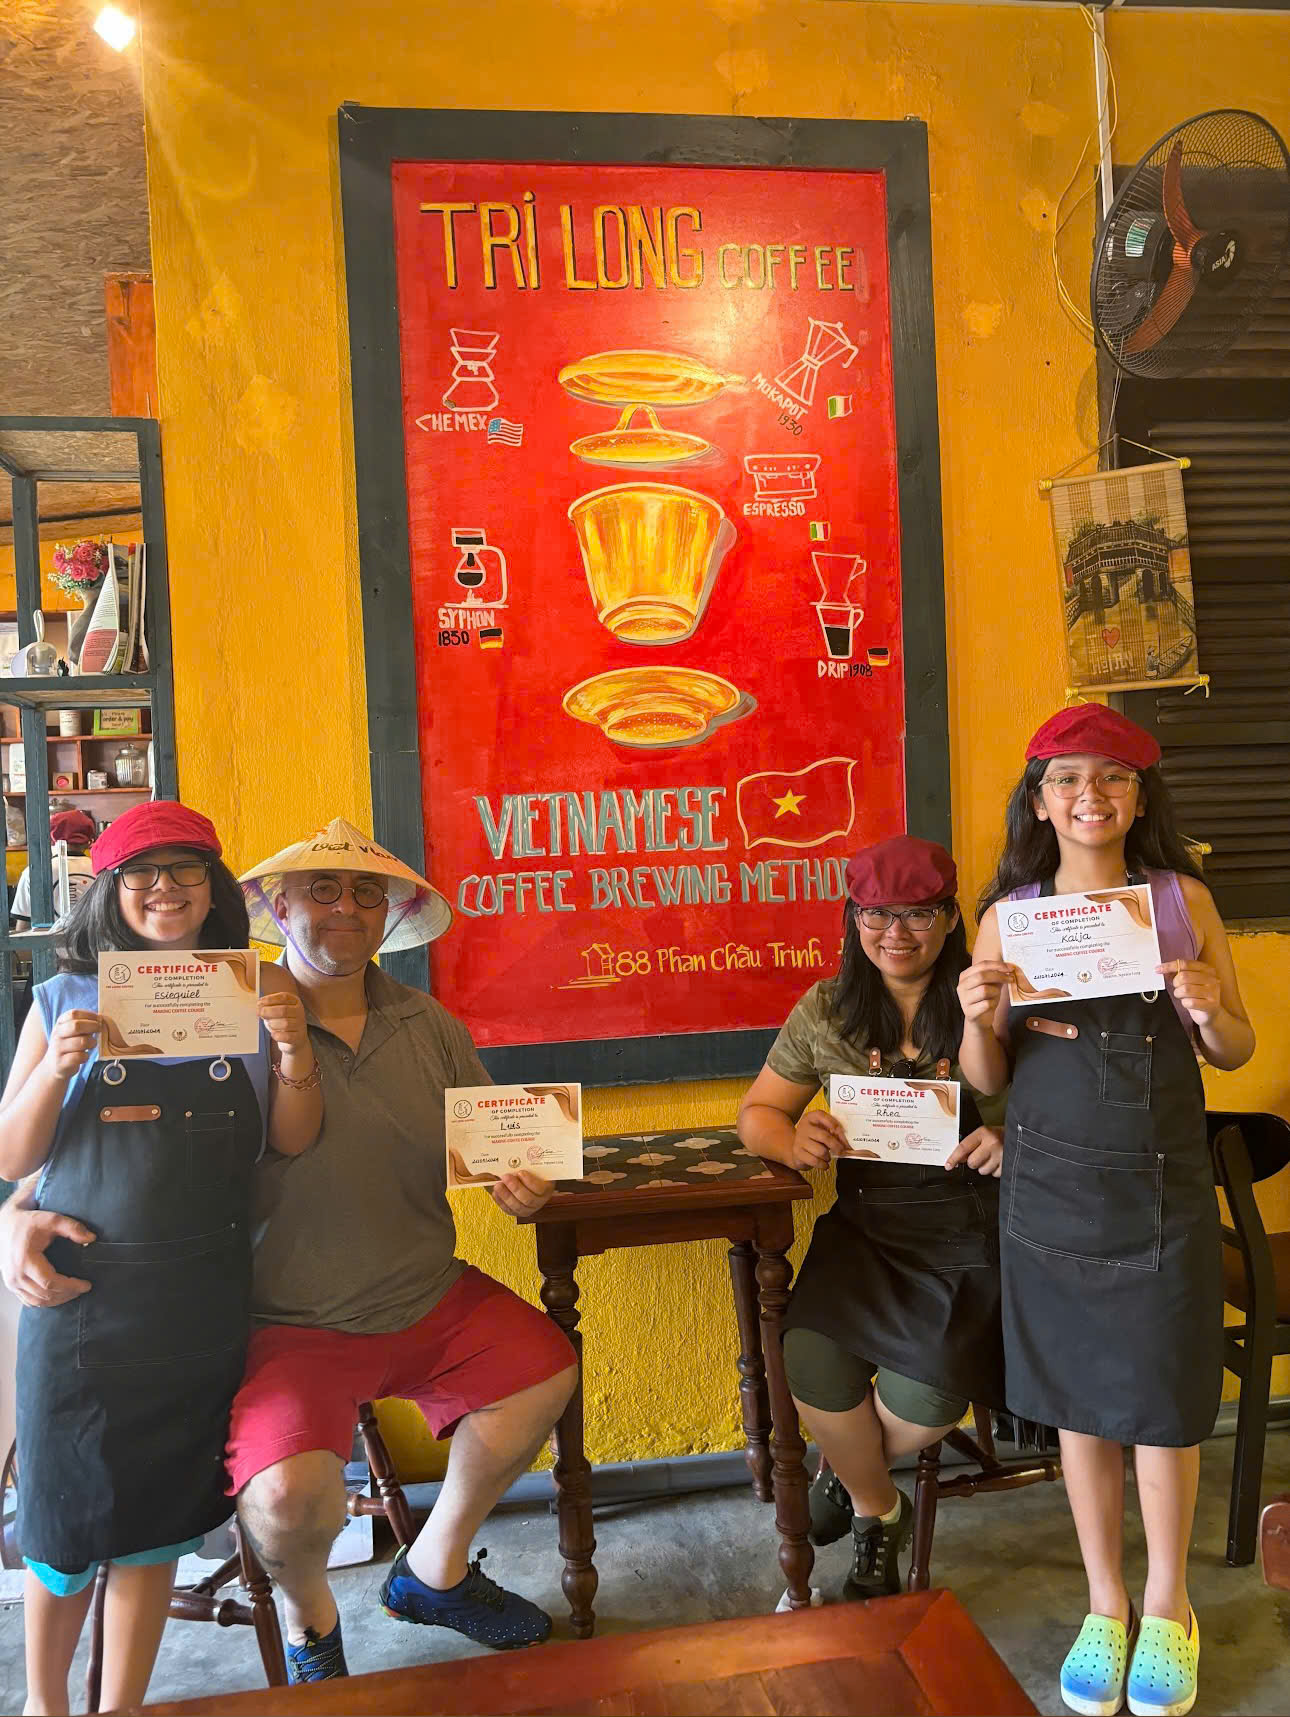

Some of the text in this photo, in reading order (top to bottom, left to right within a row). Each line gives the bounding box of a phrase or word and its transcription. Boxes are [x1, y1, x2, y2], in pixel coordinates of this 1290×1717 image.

[560, 205, 704, 290] LONG
[718, 243, 854, 291] COFFEE
[752, 372, 808, 420] MOKAPOT
[416, 412, 487, 432] CHEMEX
[777, 413, 803, 436] 1930
[743, 501, 805, 517] ESPRESSO
[438, 608, 495, 630] SYPHON
[818, 660, 848, 679] DRIP
[473, 787, 728, 860] VIETNAMESE
[458, 870, 576, 917] COFFEE
[588, 864, 732, 909] BREWING
[1034, 904, 1112, 920] CERTIFICATE
[1061, 916, 1100, 925] COMPLETION
[1061, 932, 1092, 944] Kaija
[616, 950, 651, 976] 88
[656, 946, 706, 973] Phan
[711, 942, 762, 971] Châu
[137, 964, 218, 975] CERTIFICATE
[860, 1088, 925, 1098] CERTIFICATE
[477, 1097, 545, 1108] CERTIFICATE
[876, 1109, 900, 1117] Rhea
[501, 1122, 520, 1131] Luis
